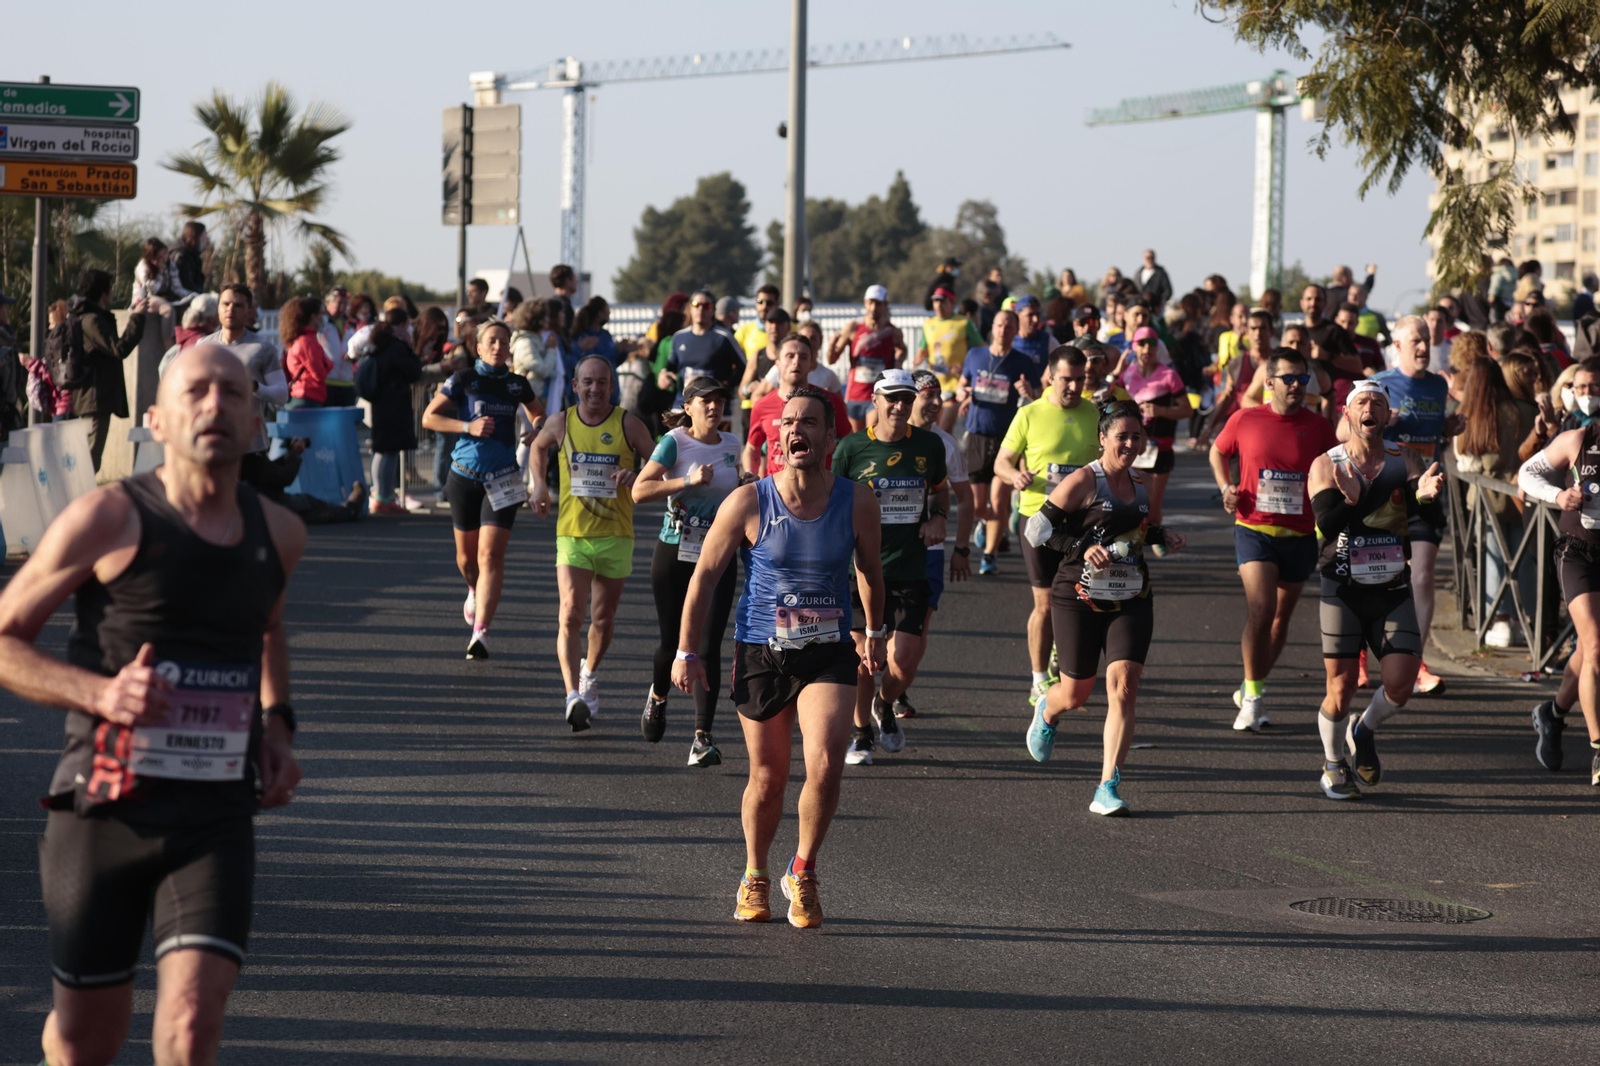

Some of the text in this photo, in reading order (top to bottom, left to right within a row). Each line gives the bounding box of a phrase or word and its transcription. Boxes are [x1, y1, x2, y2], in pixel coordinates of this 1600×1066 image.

[3, 88, 17, 98] de
[83, 128, 132, 140] hospital
[9, 136, 56, 152] Virgen
[62, 139, 85, 151] del
[27, 167, 130, 180] estación Prado
[20, 178, 130, 193] San Sebastián
[586, 469, 603, 477] 7884
[1580, 464, 1598, 476] LOS
[1273, 472, 1300, 480] ZURICH
[890, 479, 920, 487] ZURICH
[1366, 537, 1397, 545] ZURICH
[1368, 552, 1386, 561] 7004
[1109, 569, 1128, 578] 9086
[799, 596, 836, 605] ZURICH
[797, 615, 821, 624] 6710
[799, 624, 819, 636] ISMA
[183, 667, 249, 687] ZURICH
[180, 705, 222, 723] 7197
[166, 733, 227, 751] ERNESTO
